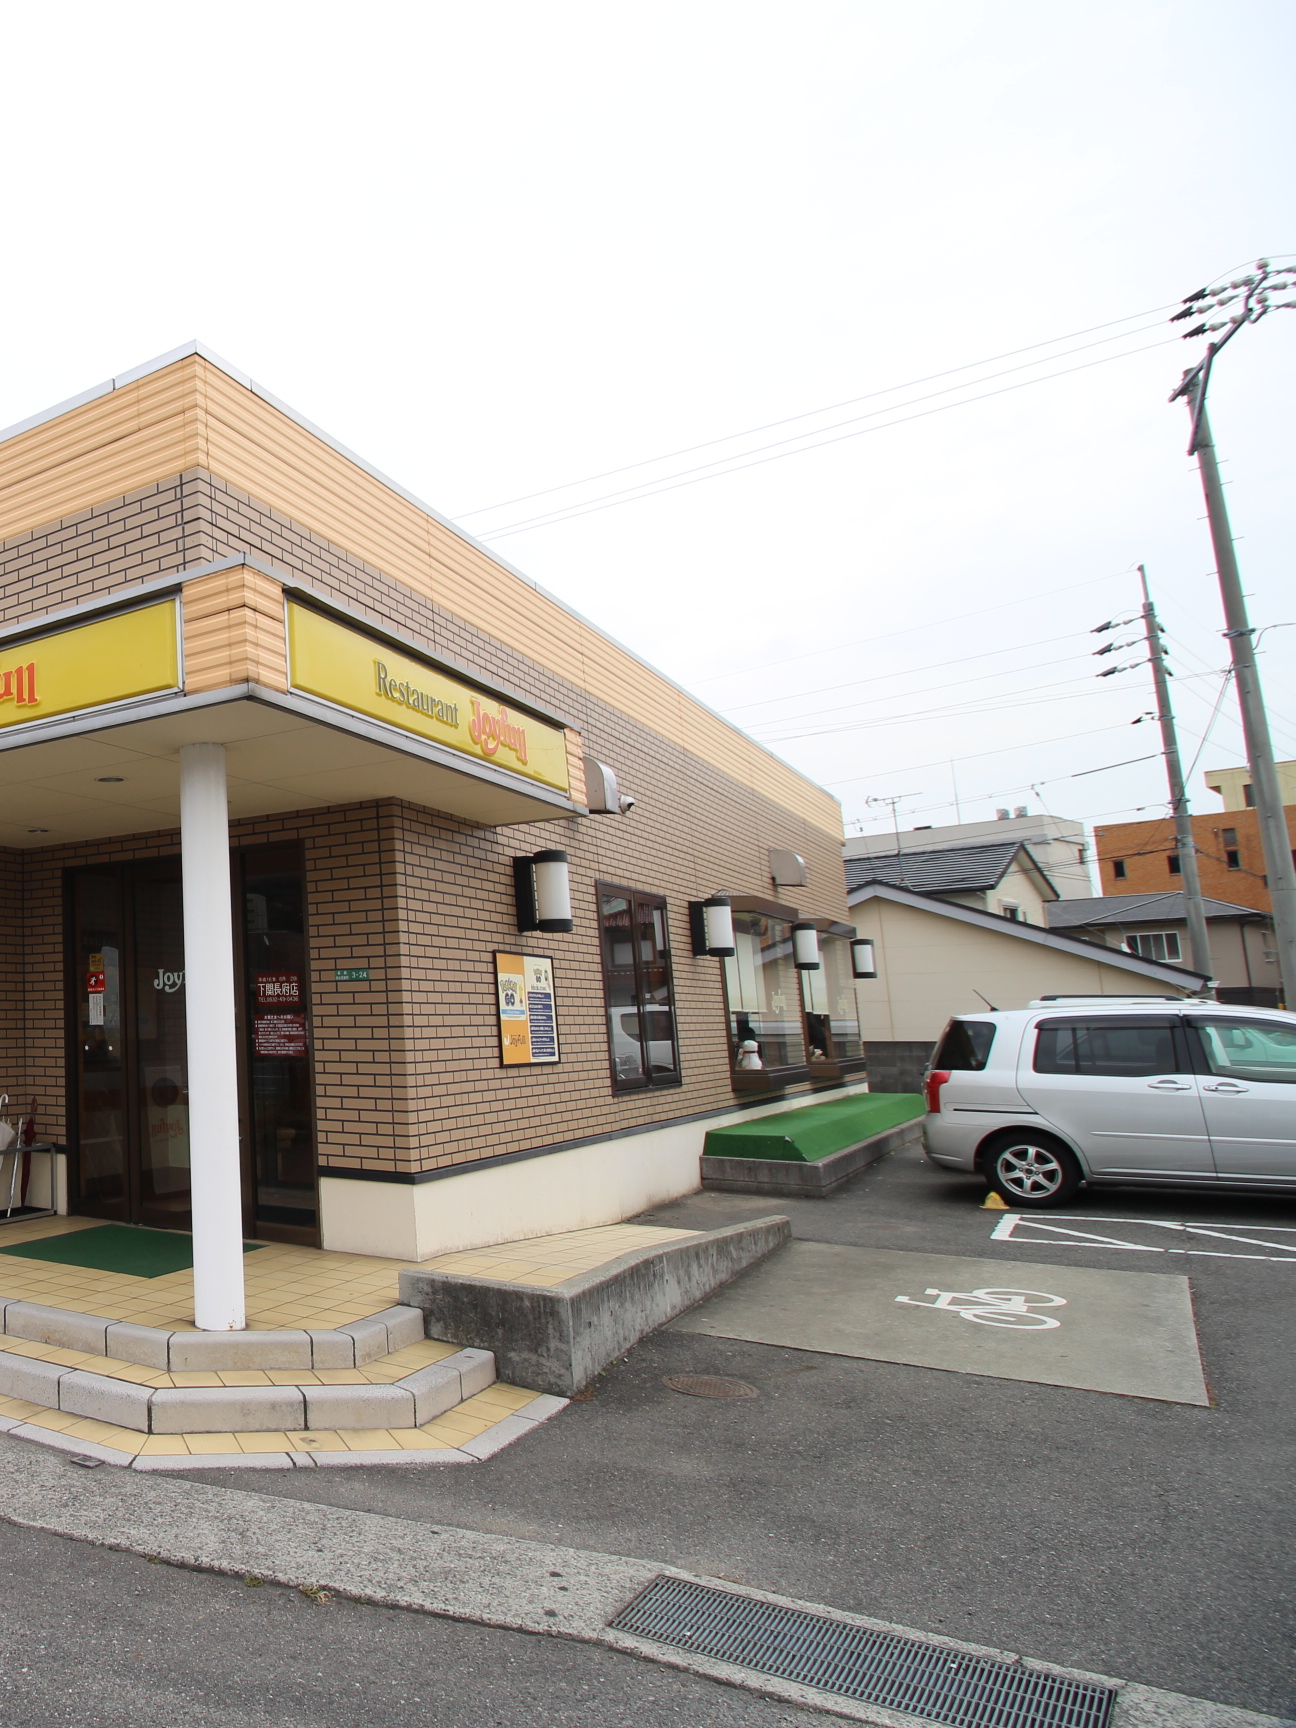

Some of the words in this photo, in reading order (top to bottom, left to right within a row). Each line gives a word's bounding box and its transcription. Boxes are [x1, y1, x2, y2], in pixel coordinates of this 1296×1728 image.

[377, 661, 460, 726] Restaurant
[471, 698, 528, 763] Joyfull
[153, 968, 185, 993] Joy
[257, 983, 299, 996] 下関長府店
